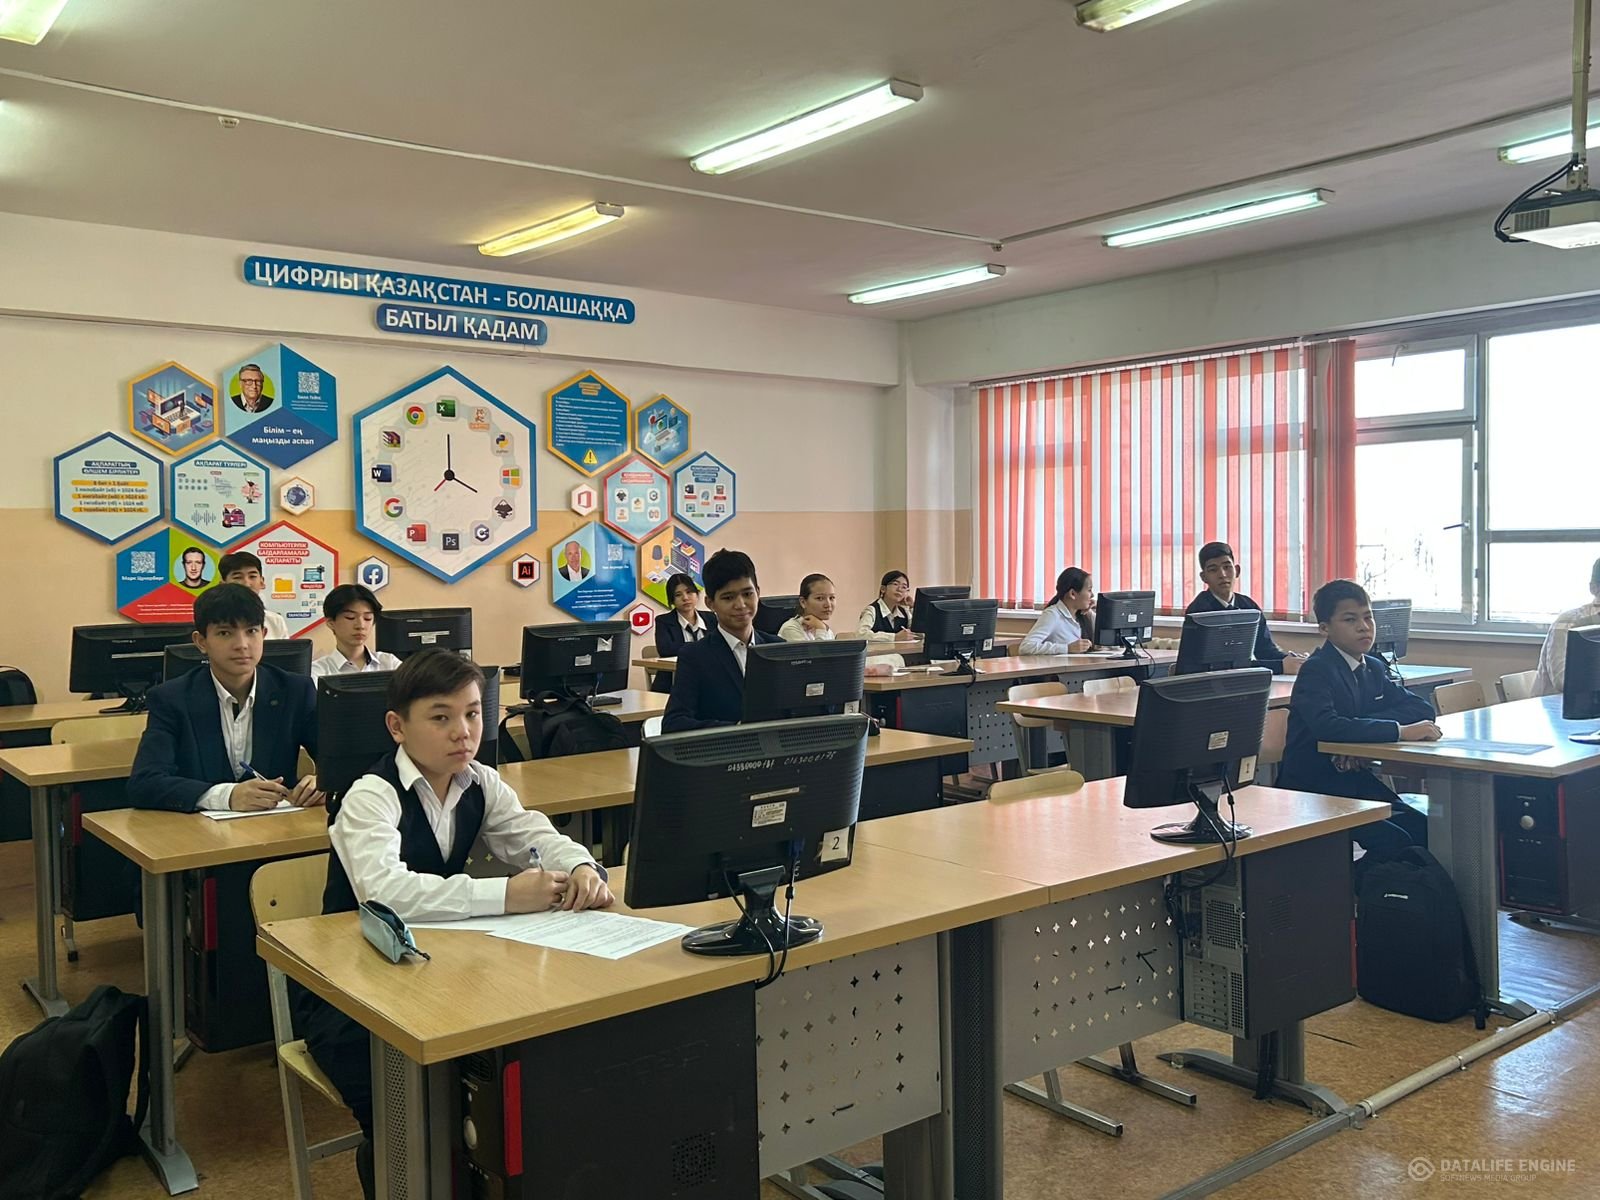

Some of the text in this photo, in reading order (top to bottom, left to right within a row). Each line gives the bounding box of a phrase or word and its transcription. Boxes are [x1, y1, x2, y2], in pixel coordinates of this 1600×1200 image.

[254, 262, 358, 291] ЦИФРЛЫ
[366, 273, 487, 304] ҚАЗАҚСТАН
[506, 290, 628, 322] БОЛАШАҚҚА
[386, 308, 538, 342] БАТЫЛ ҚАДАМ
[263, 426, 284, 434] Білім
[252, 437, 290, 445] маңызды
[445, 537, 457, 546] Ps
[521, 566, 531, 575] Ai
[832, 836, 840, 850] 2
